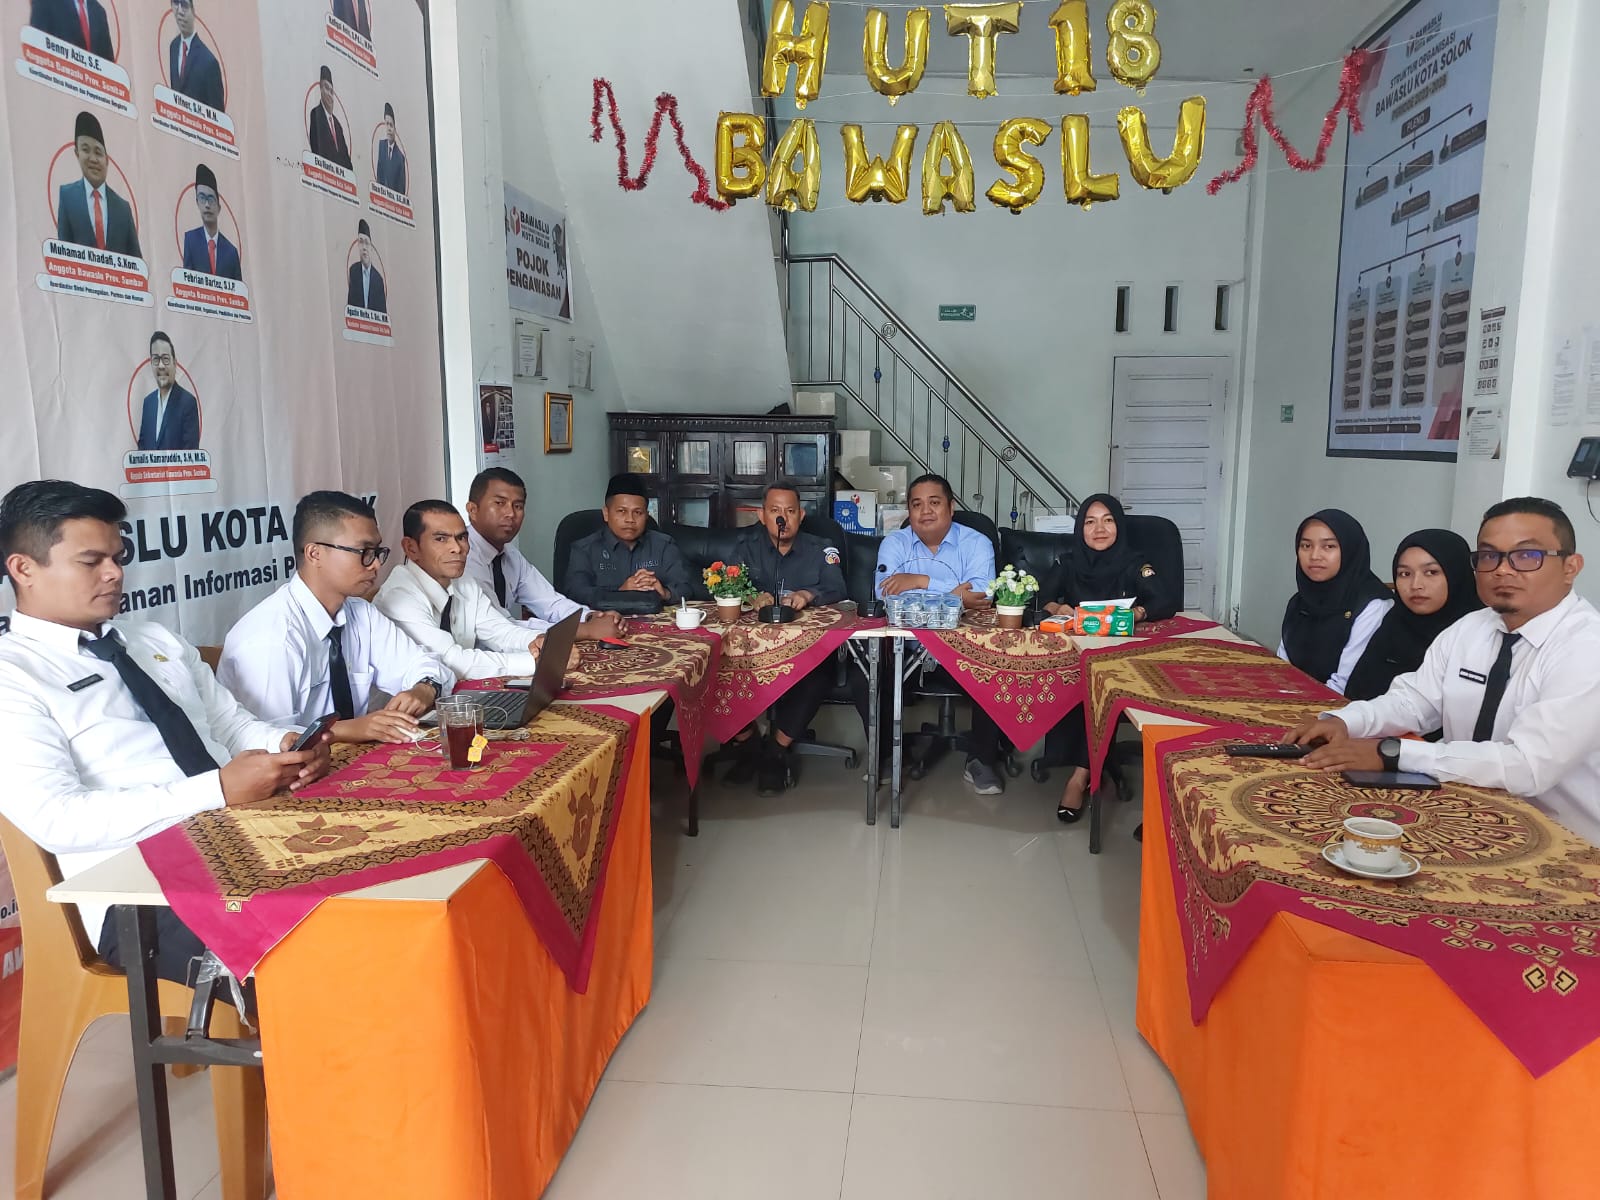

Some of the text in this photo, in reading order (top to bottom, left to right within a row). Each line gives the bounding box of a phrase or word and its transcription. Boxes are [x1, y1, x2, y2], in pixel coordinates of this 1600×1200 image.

[45, 36, 102, 71] Benny Aziz, S.E.
[1390, 59, 1418, 89] STRUKTUR
[1418, 29, 1457, 67] ORGANISASI
[1375, 76, 1414, 118] BAWASLU
[1414, 59, 1438, 92] KOTA
[1440, 32, 1474, 71] SOLOK
[714, 97, 1206, 215] BAWASLU
[520, 211, 550, 235] BAWASLU
[521, 230, 535, 243] KOTA
[48, 262, 76, 276] Anggota
[77, 268, 104, 280] Bawaslu
[49, 242, 140, 272] Muhamad Khadafi, S.Kom.
[516, 247, 550, 277] POJOK
[183, 271, 204, 285] Febrian
[201, 505, 288, 553] KOTA
[184, 558, 278, 600] Informasi
